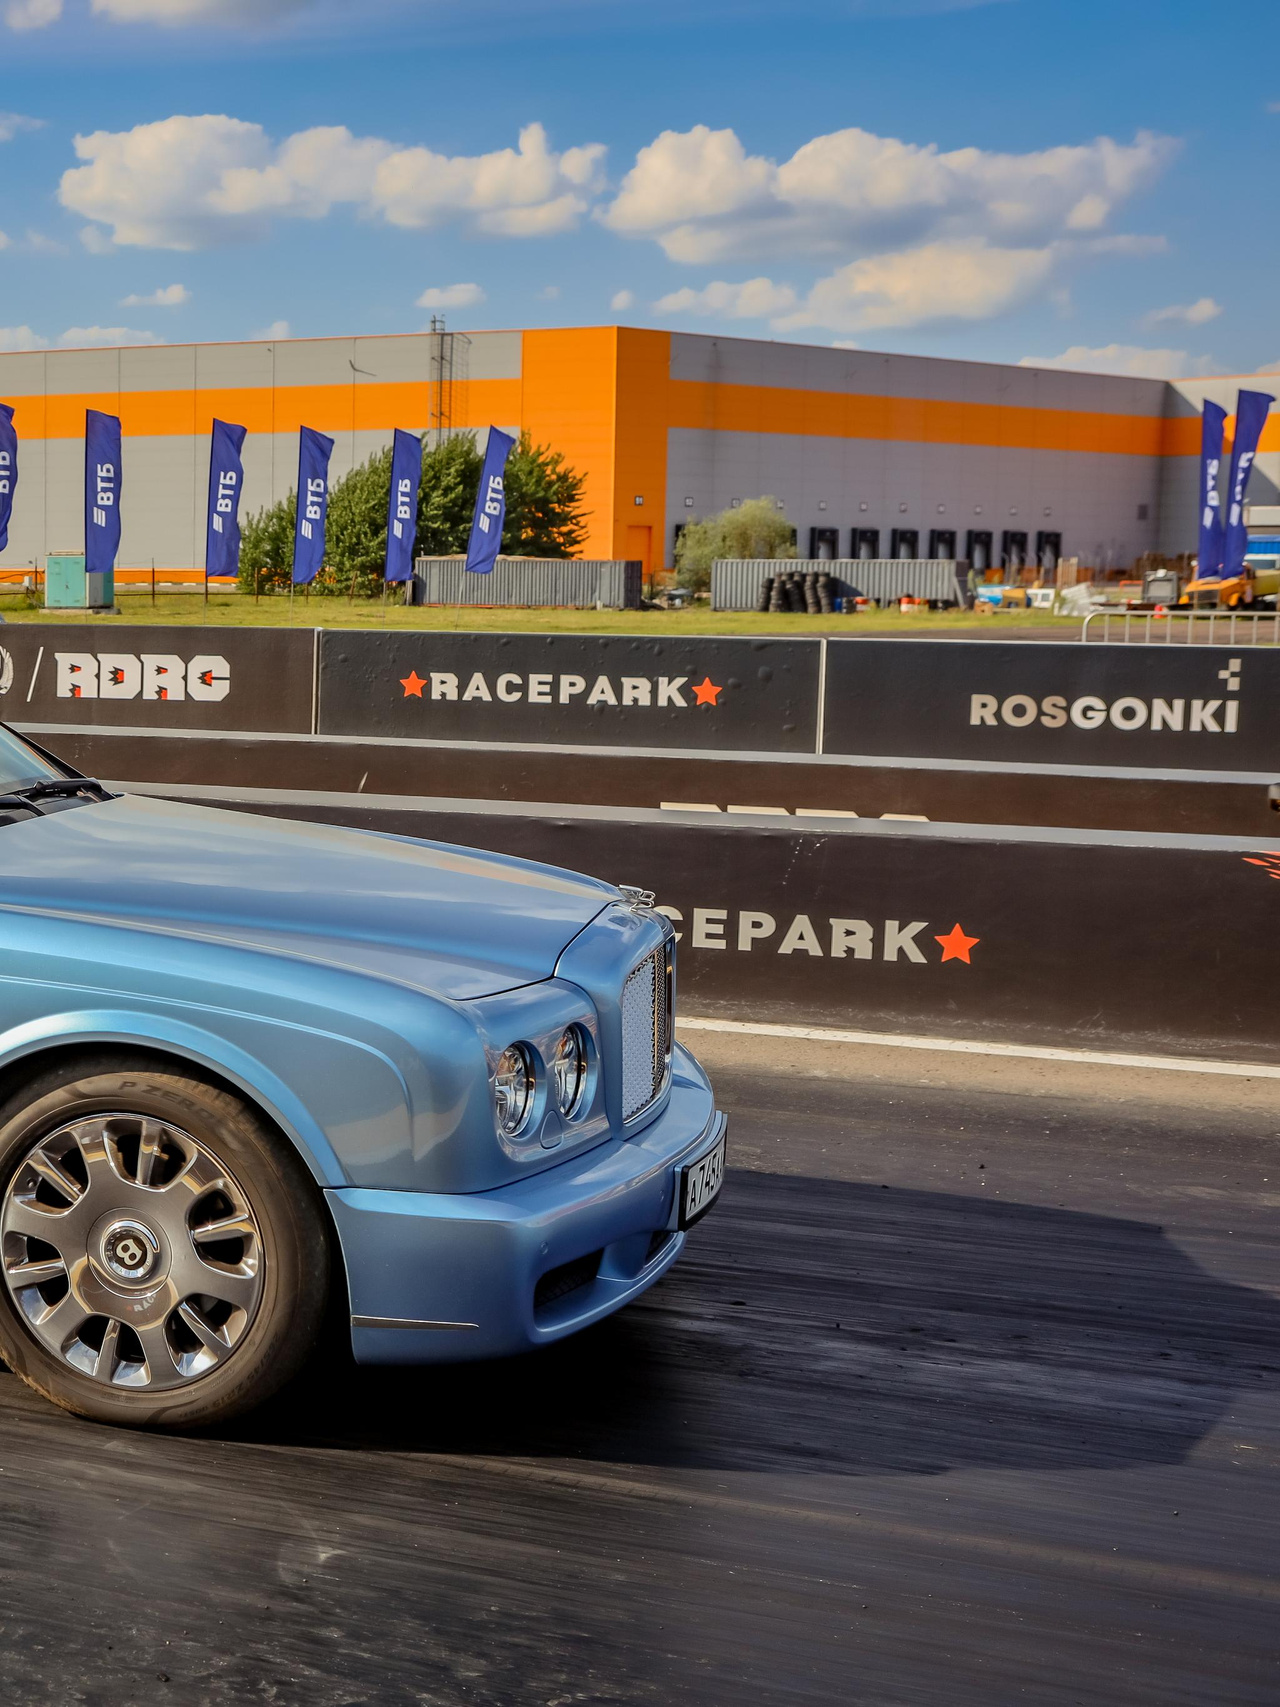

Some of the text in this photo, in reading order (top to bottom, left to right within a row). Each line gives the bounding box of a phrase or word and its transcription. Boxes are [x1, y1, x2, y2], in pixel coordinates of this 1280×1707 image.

[97, 463, 114, 506] ВТБ
[217, 470, 237, 513] ВТБ
[305, 478, 325, 520] ВТБ
[397, 478, 411, 520] ВТБ
[484, 475, 503, 517] ВТБ
[54, 652, 231, 702] RDRC
[430, 671, 689, 707] RACEPARK
[969, 693, 1240, 733] ROSGONKI
